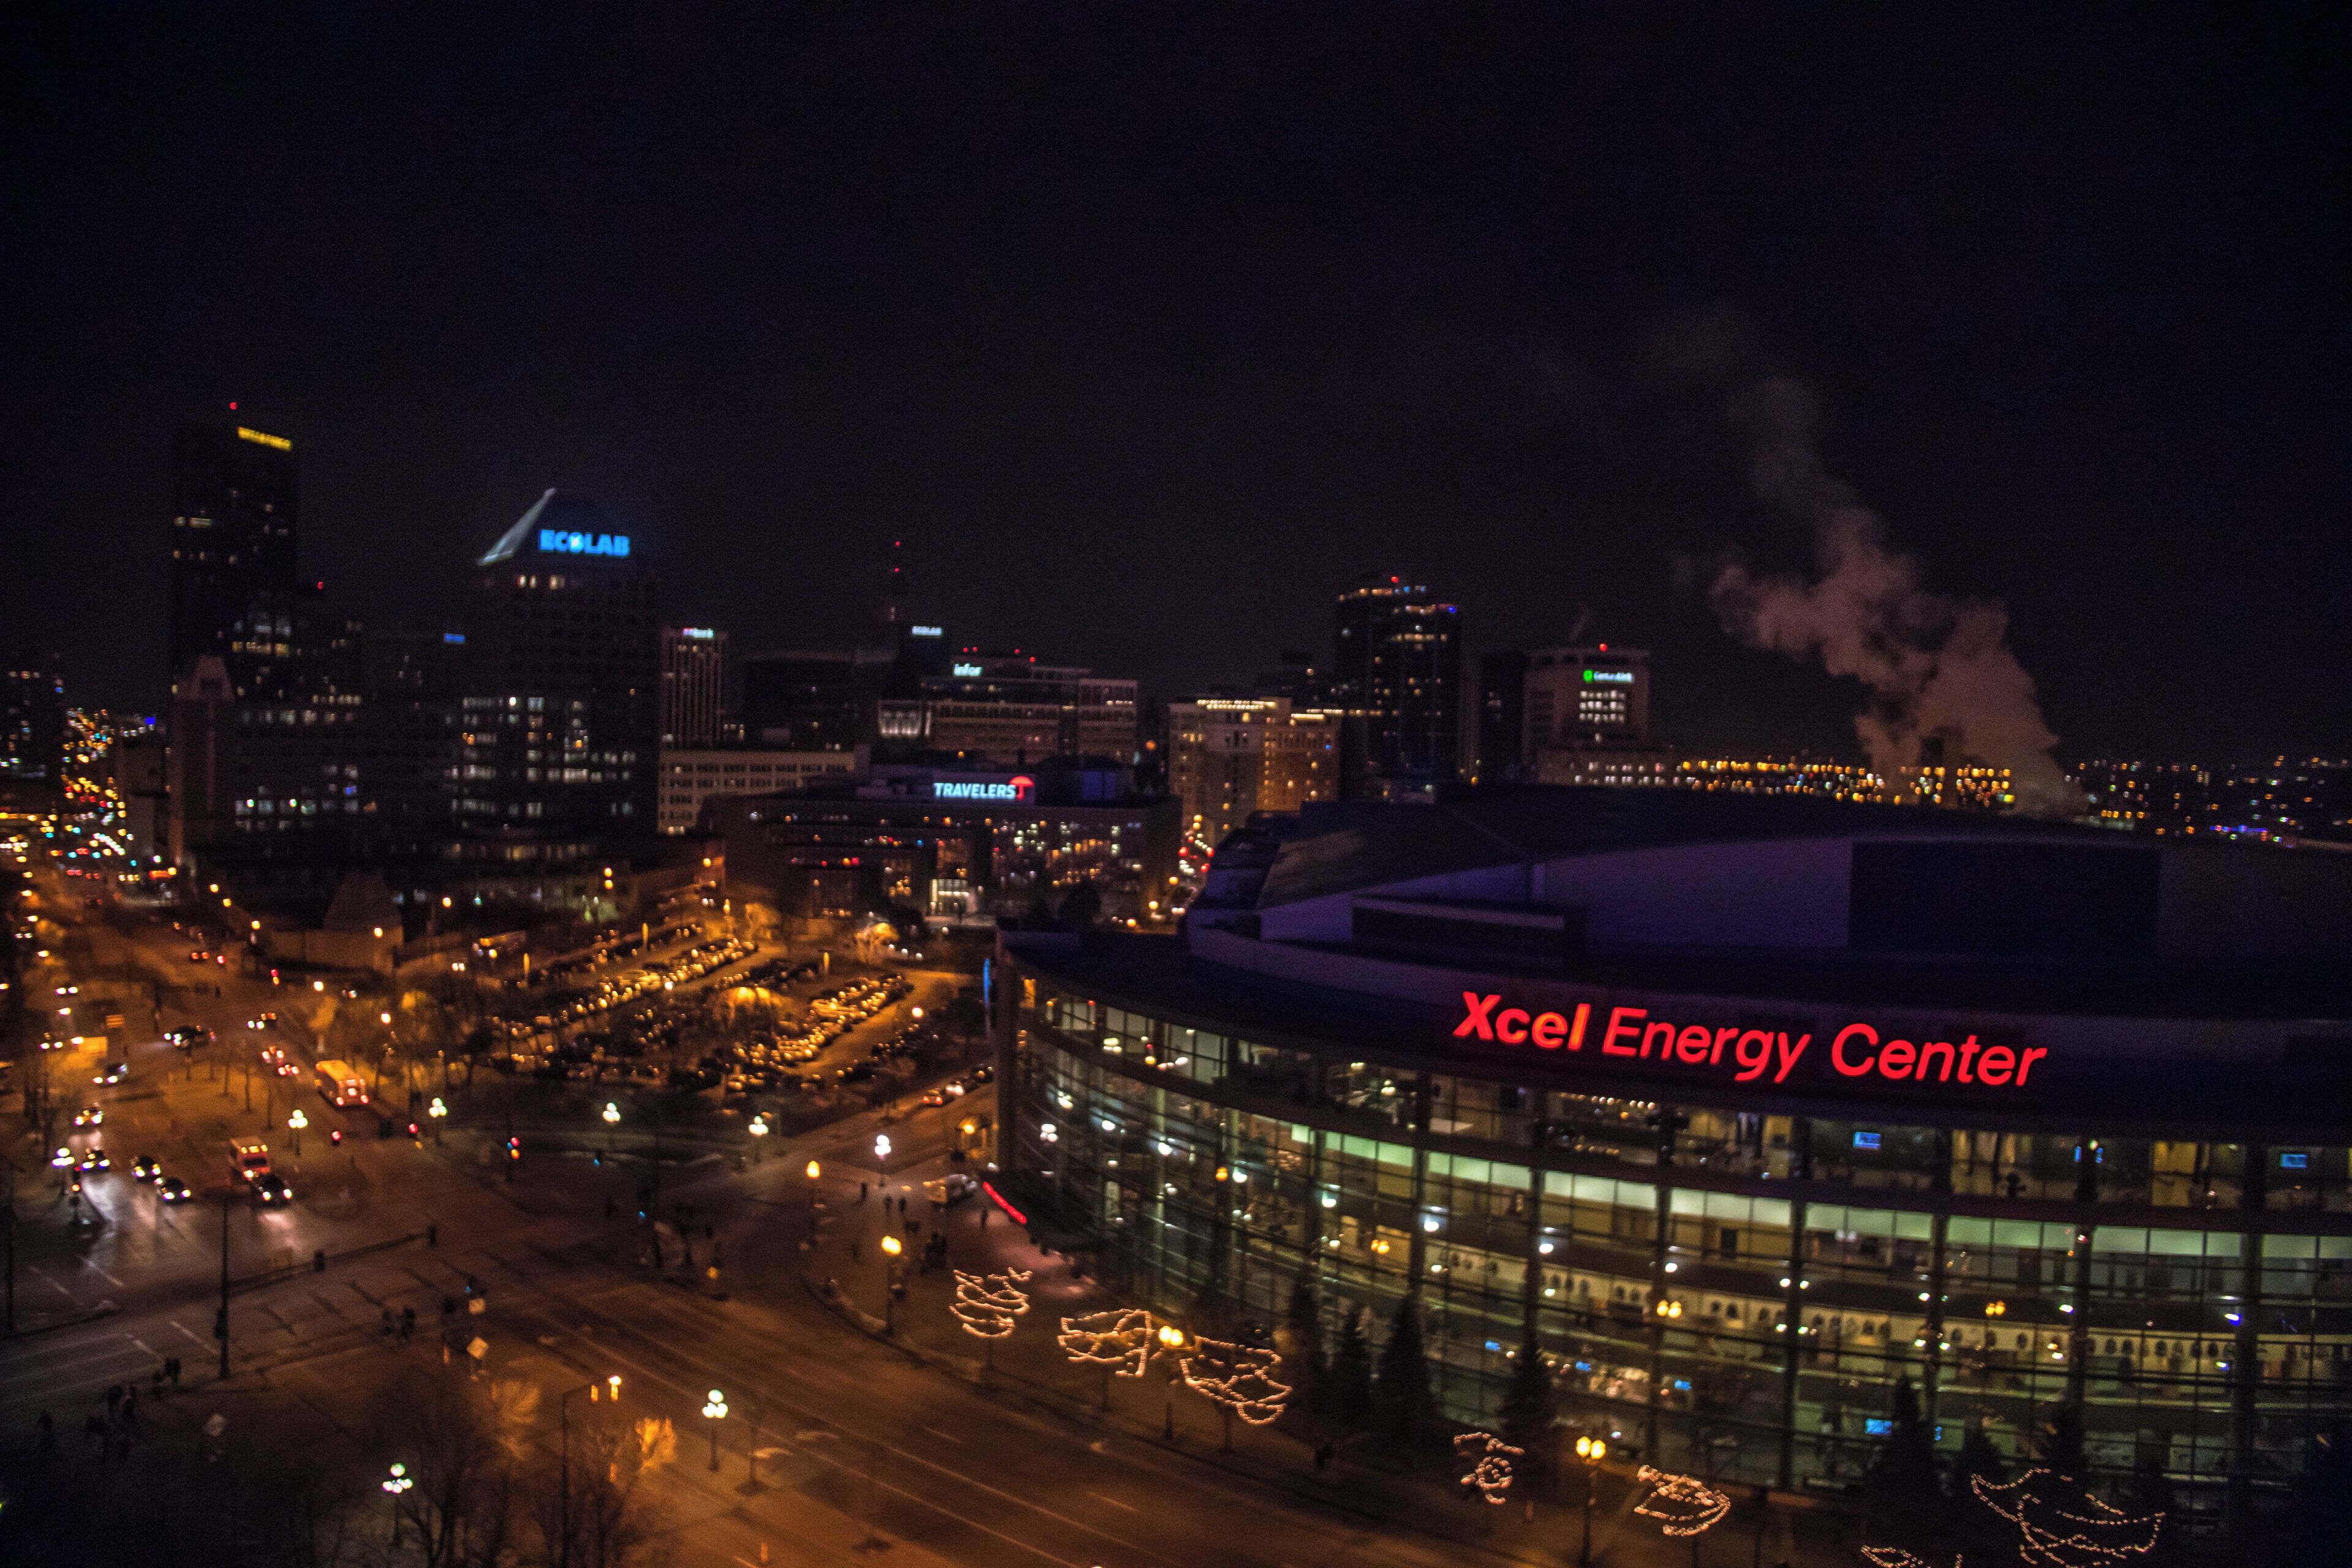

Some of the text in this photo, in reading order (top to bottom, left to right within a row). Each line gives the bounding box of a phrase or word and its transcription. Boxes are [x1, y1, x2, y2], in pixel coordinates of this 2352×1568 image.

[538, 529, 630, 557] ECOLAB
[932, 782, 1017, 800] TRAVELERS
[1453, 991, 2048, 1086] Xcel Energy Center
